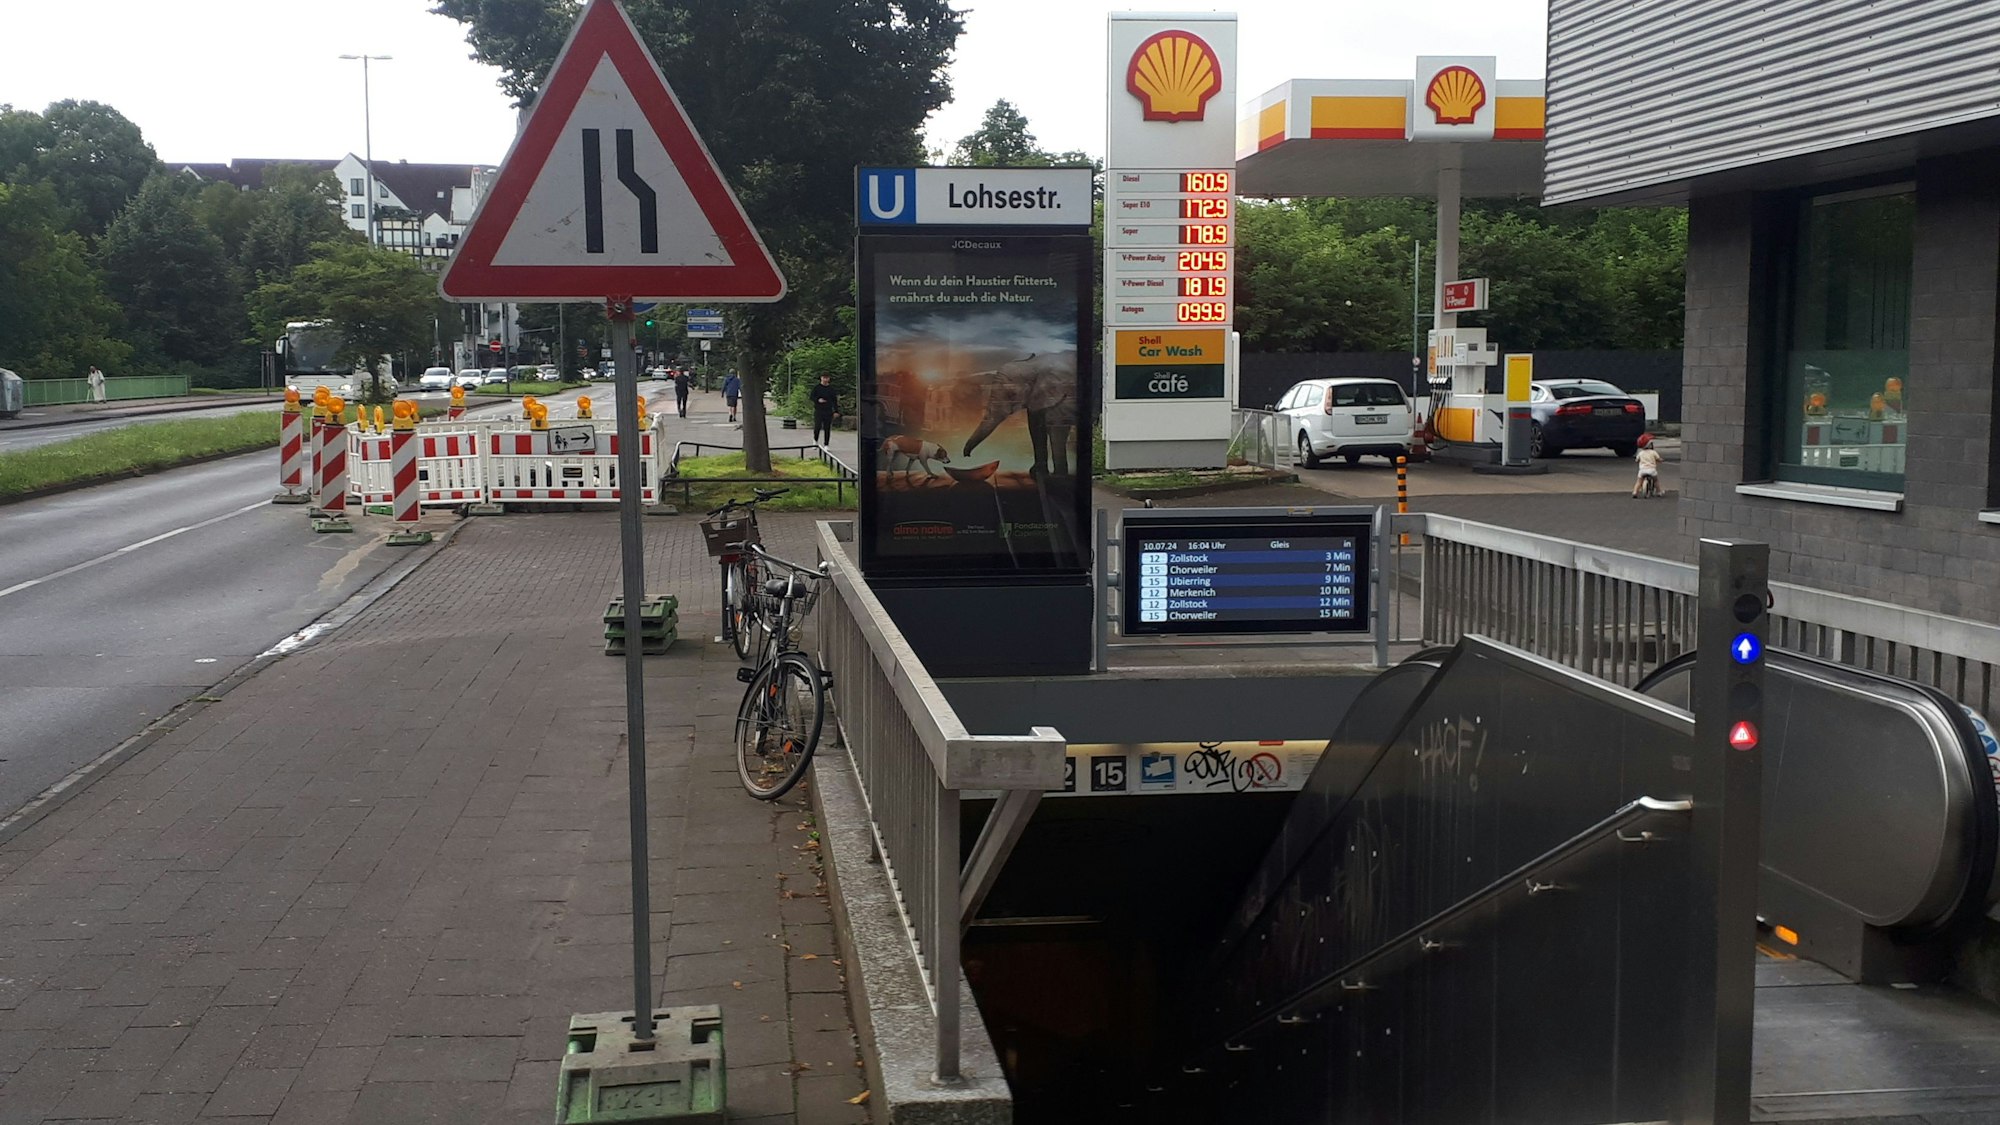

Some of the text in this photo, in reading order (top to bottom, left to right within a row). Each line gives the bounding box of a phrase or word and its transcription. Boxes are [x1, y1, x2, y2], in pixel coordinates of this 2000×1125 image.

[1186, 173, 1228, 192] 160.9
[869, 175, 1061, 219] U Lohsestr.
[1186, 199, 1227, 218] 172.9
[1186, 225, 1227, 244] 178.9
[952, 240, 1001, 249] JCDecaux
[1179, 252, 1226, 270] 204.9
[890, 274, 1057, 288] Wenn du dein Haustier fütterst,
[890, 292, 1033, 303] ernährst du auch die Natur.
[1178, 303, 1225, 321] 099.9
[1139, 336, 1161, 344] Shell
[1139, 345, 1202, 356] Car Wash
[1148, 374, 1189, 392] café
[1188, 542, 1209, 550] 16:04
[1212, 542, 1226, 550] Uhr
[1344, 540, 1351, 548] in
[1170, 554, 1208, 562] Zollstock
[1325, 552, 1331, 560] 3
[1333, 552, 1351, 560] Min
[1150, 564, 1351, 574] 15 Chorweiler 7 Min
[1150, 575, 1350, 587] 15 Ubierring 9 Min
[1150, 587, 1350, 597] 12 Merkenich 10 Min
[1150, 598, 1350, 608] 12 Zollstock 12 Min
[1170, 611, 1217, 619] Chorweiler
[1319, 610, 1330, 618] 15
[1333, 610, 1350, 618] Min
[1096, 762, 1123, 785] 15
